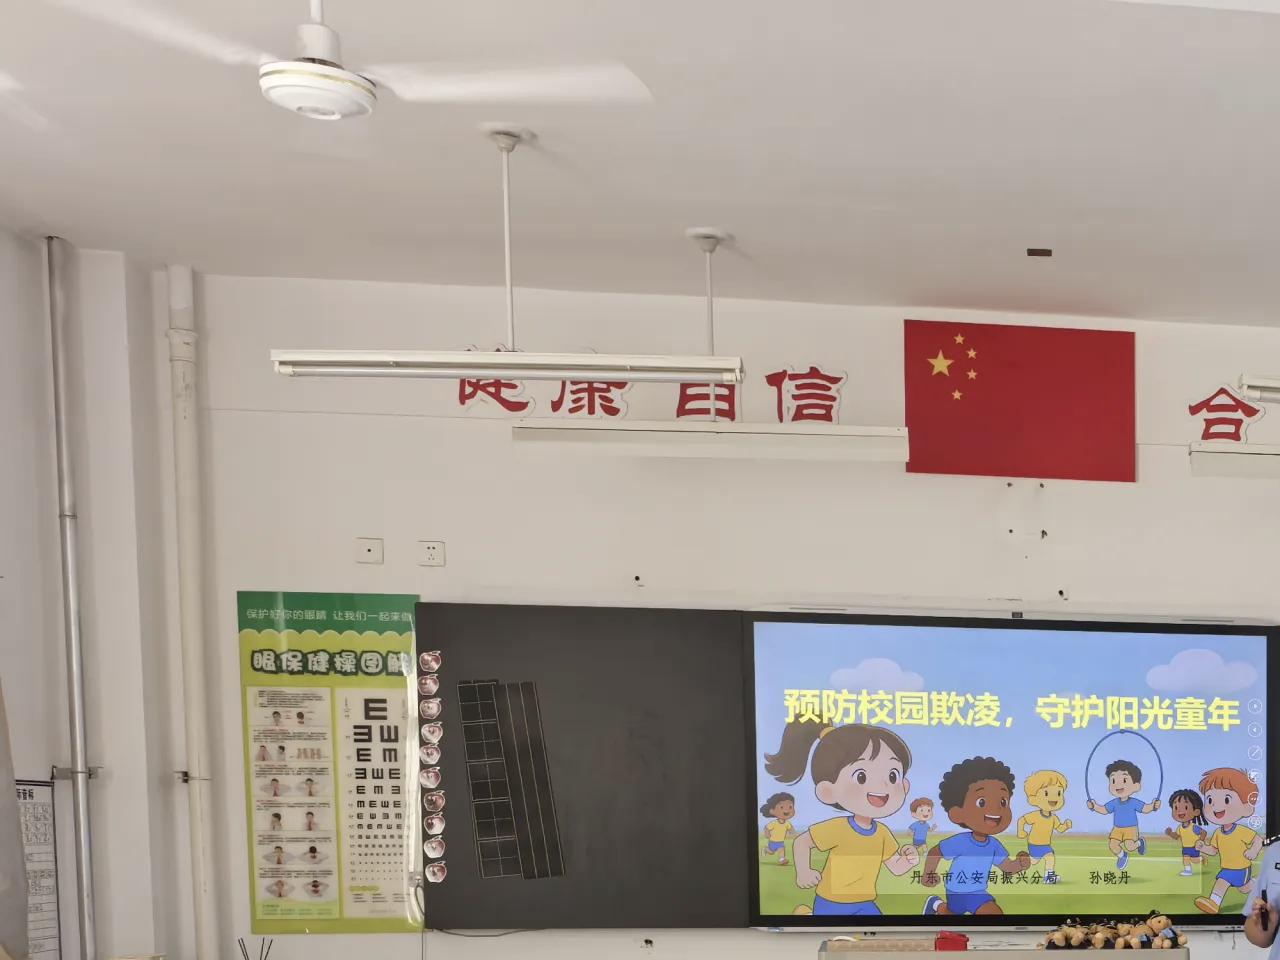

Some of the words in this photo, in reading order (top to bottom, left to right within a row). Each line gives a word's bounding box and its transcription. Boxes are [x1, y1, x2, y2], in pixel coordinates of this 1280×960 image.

[247, 608, 326, 621] 保护好你的眼睛
[783, 688, 1242, 732] 预防校园欺凌，守护阳光童年
[910, 870, 1059, 886] 丹东市公安局振兴分局
[1089, 870, 1131, 886] 孙晓丹
